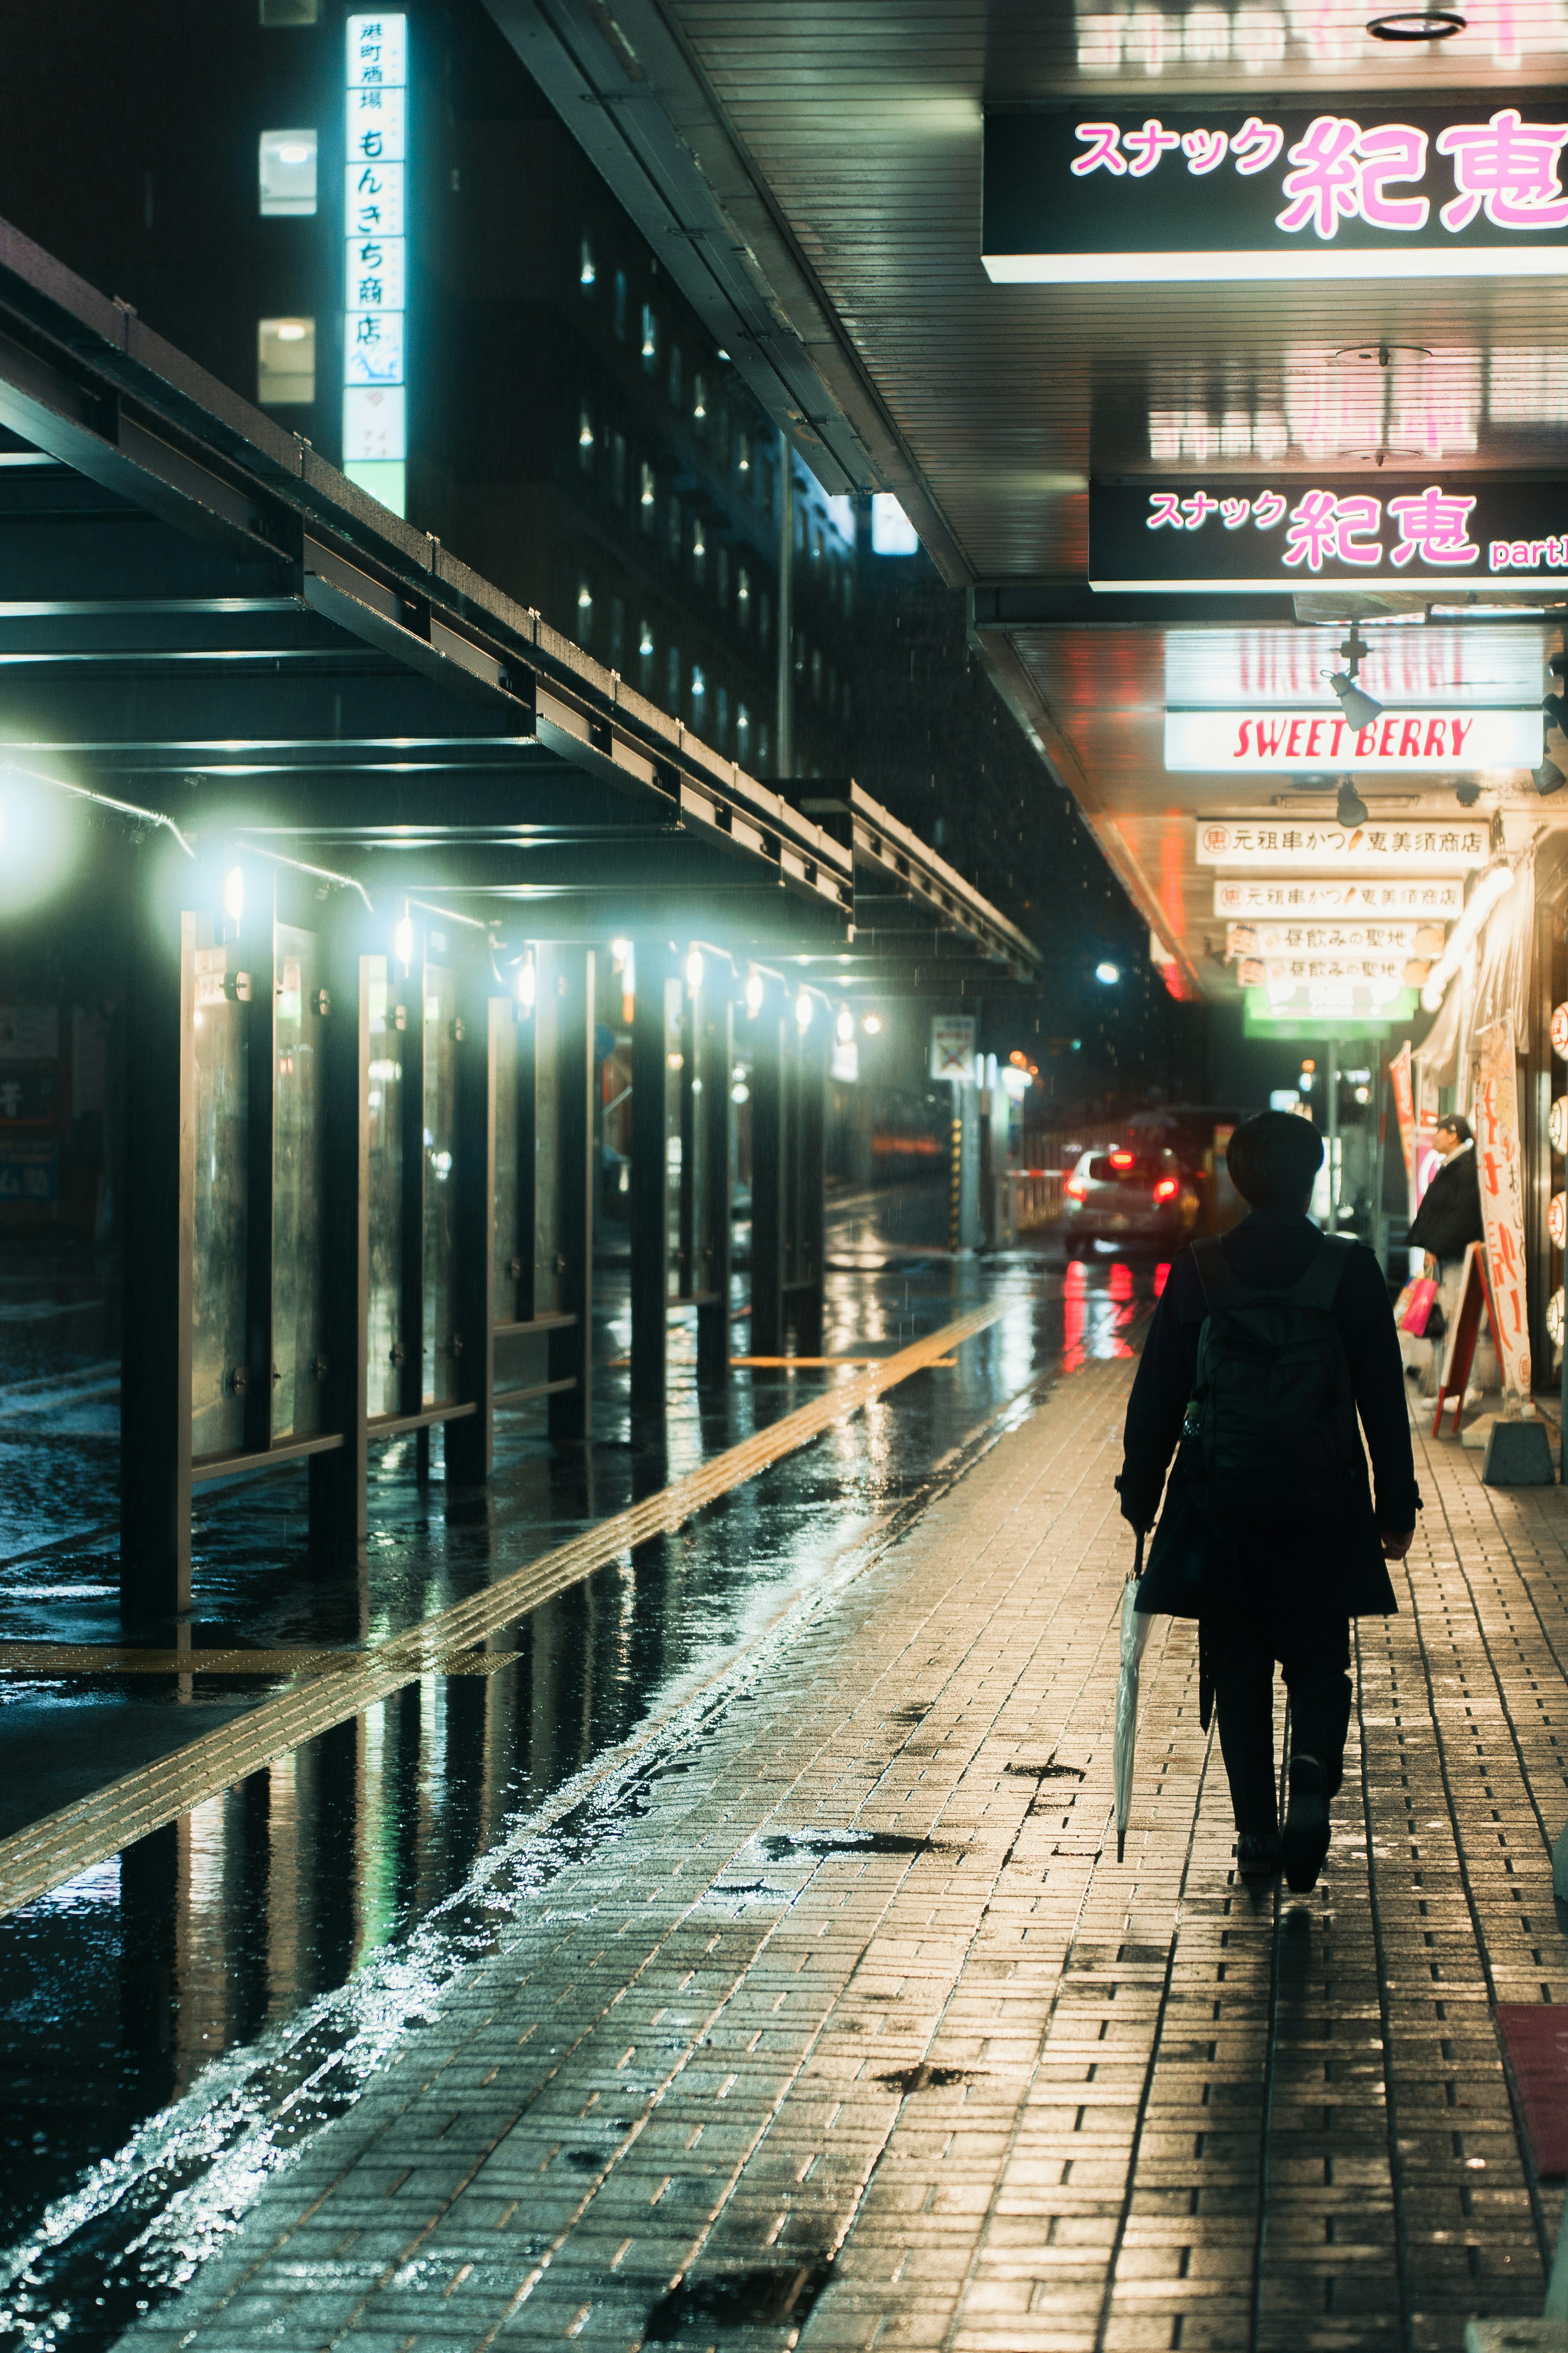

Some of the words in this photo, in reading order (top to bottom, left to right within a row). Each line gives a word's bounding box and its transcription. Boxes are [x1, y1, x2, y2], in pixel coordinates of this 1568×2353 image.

[1071, 118, 1285, 177] スナック
[1275, 109, 1568, 240] 紀恵
[357, 130, 383, 345] もんきち商店
[1147, 490, 1287, 530] スナック
[1283, 486, 1479, 571] 紀恵
[1234, 718, 1348, 757] SWEET
[1354, 718, 1473, 757] BERRY
[1233, 830, 1345, 852] 元祖串かつ
[1367, 832, 1482, 852] 恵美須商店
[1247, 888, 1341, 906] 元祖串かつ
[1360, 888, 1457, 906] 恵美須商店
[1285, 929, 1406, 948] 昼飲みの聖地
[1290, 961, 1397, 977] 昼飲みの聖地
